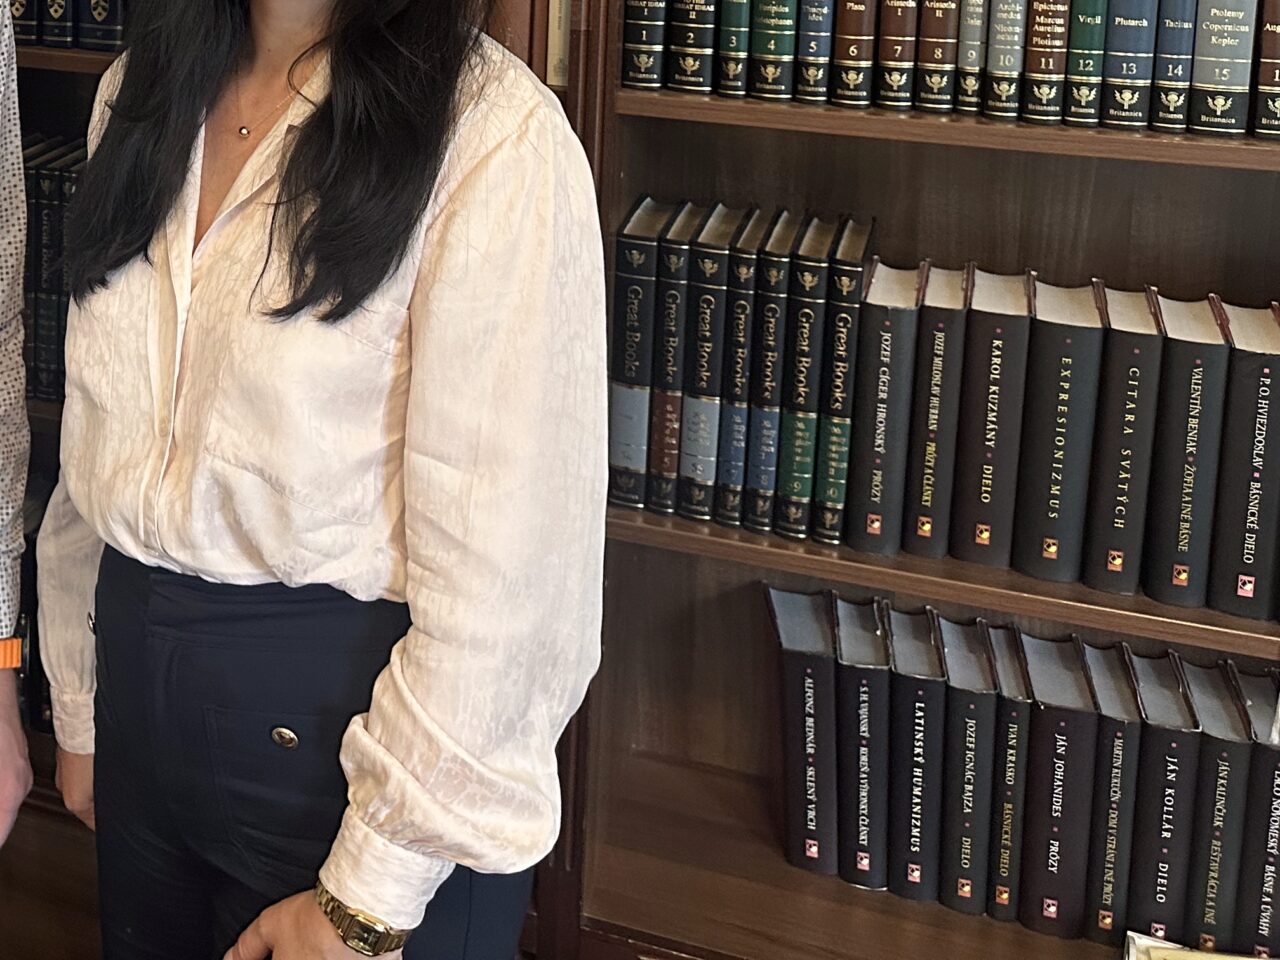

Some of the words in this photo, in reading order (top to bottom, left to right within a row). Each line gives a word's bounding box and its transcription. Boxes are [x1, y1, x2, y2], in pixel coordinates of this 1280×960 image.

[1078, 60, 1093, 71] 12
[1121, 63, 1137, 74] 13
[990, 339, 1002, 379] KAROL
[985, 385, 1000, 447] KUZMÁNY
[1124, 367, 1140, 434] CITARA
[1049, 357, 1071, 518] EXPRESIONIZMUS
[1253, 398, 1270, 469] HVIEZDOSLAV
[982, 465, 992, 502] DIELO
[1114, 448, 1133, 528] SVÄTÝCH
[1247, 482, 1261, 529] BÁSNICKÉ
[1243, 533, 1257, 563] DIELO
[805, 677, 813, 713] ALFONZ
[805, 717, 814, 754] BEDNÁR
[913, 702, 925, 763] LATINSKÝ
[965, 719, 976, 748] JOZEF
[1054, 733, 1067, 754] JÁN
[806, 766, 816, 800] SKLENÝ
[964, 750, 974, 781] IGNÁC
[1164, 756, 1178, 780] JÁN
[962, 783, 972, 813] BAJZA
[1052, 758, 1065, 817] JOHANIDES
[807, 804, 815, 829] VRCH
[910, 769, 922, 852] HUMANIZMUS
[1161, 789, 1175, 838] KOLLÁR
[961, 837, 971, 868] DIELO
[1047, 841, 1059, 873] PRÓZY
[1156, 863, 1168, 902] DIELO
